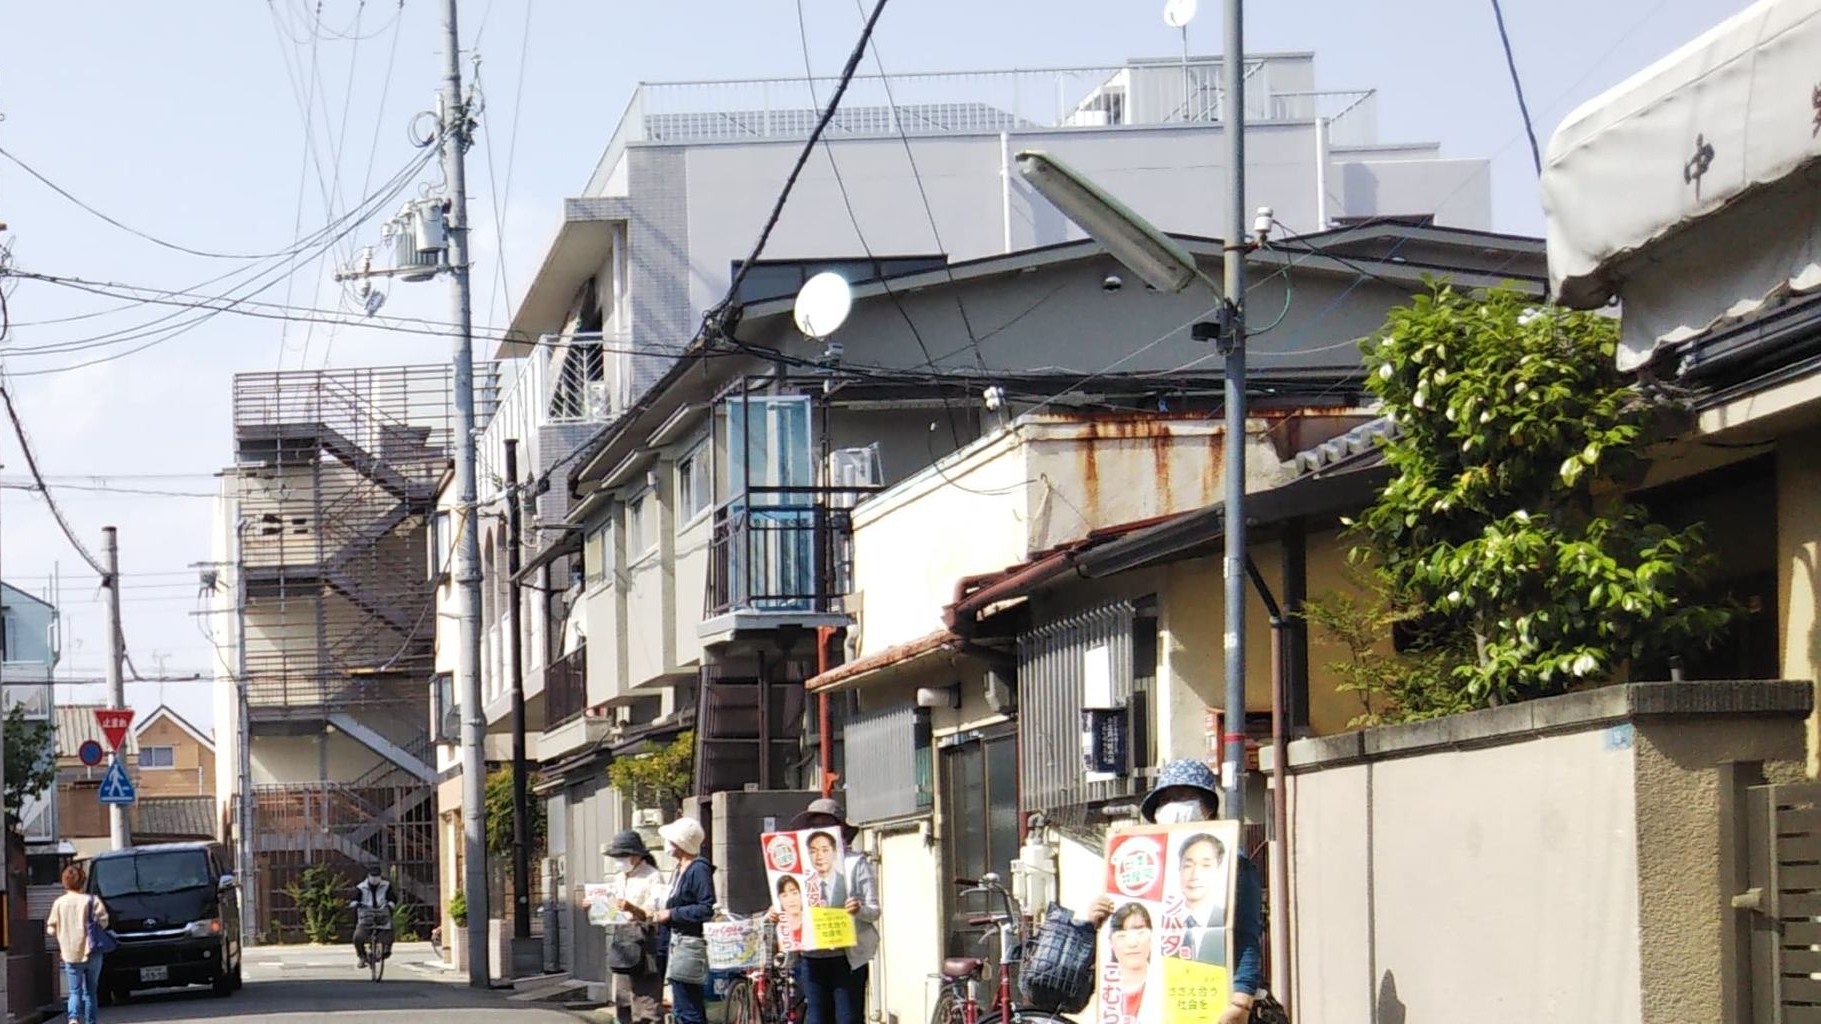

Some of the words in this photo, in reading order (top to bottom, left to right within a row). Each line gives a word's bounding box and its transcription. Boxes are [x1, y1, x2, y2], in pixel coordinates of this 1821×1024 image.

[102, 718, 128, 729] 止まれ
[1164, 895, 1185, 954] シバタ
